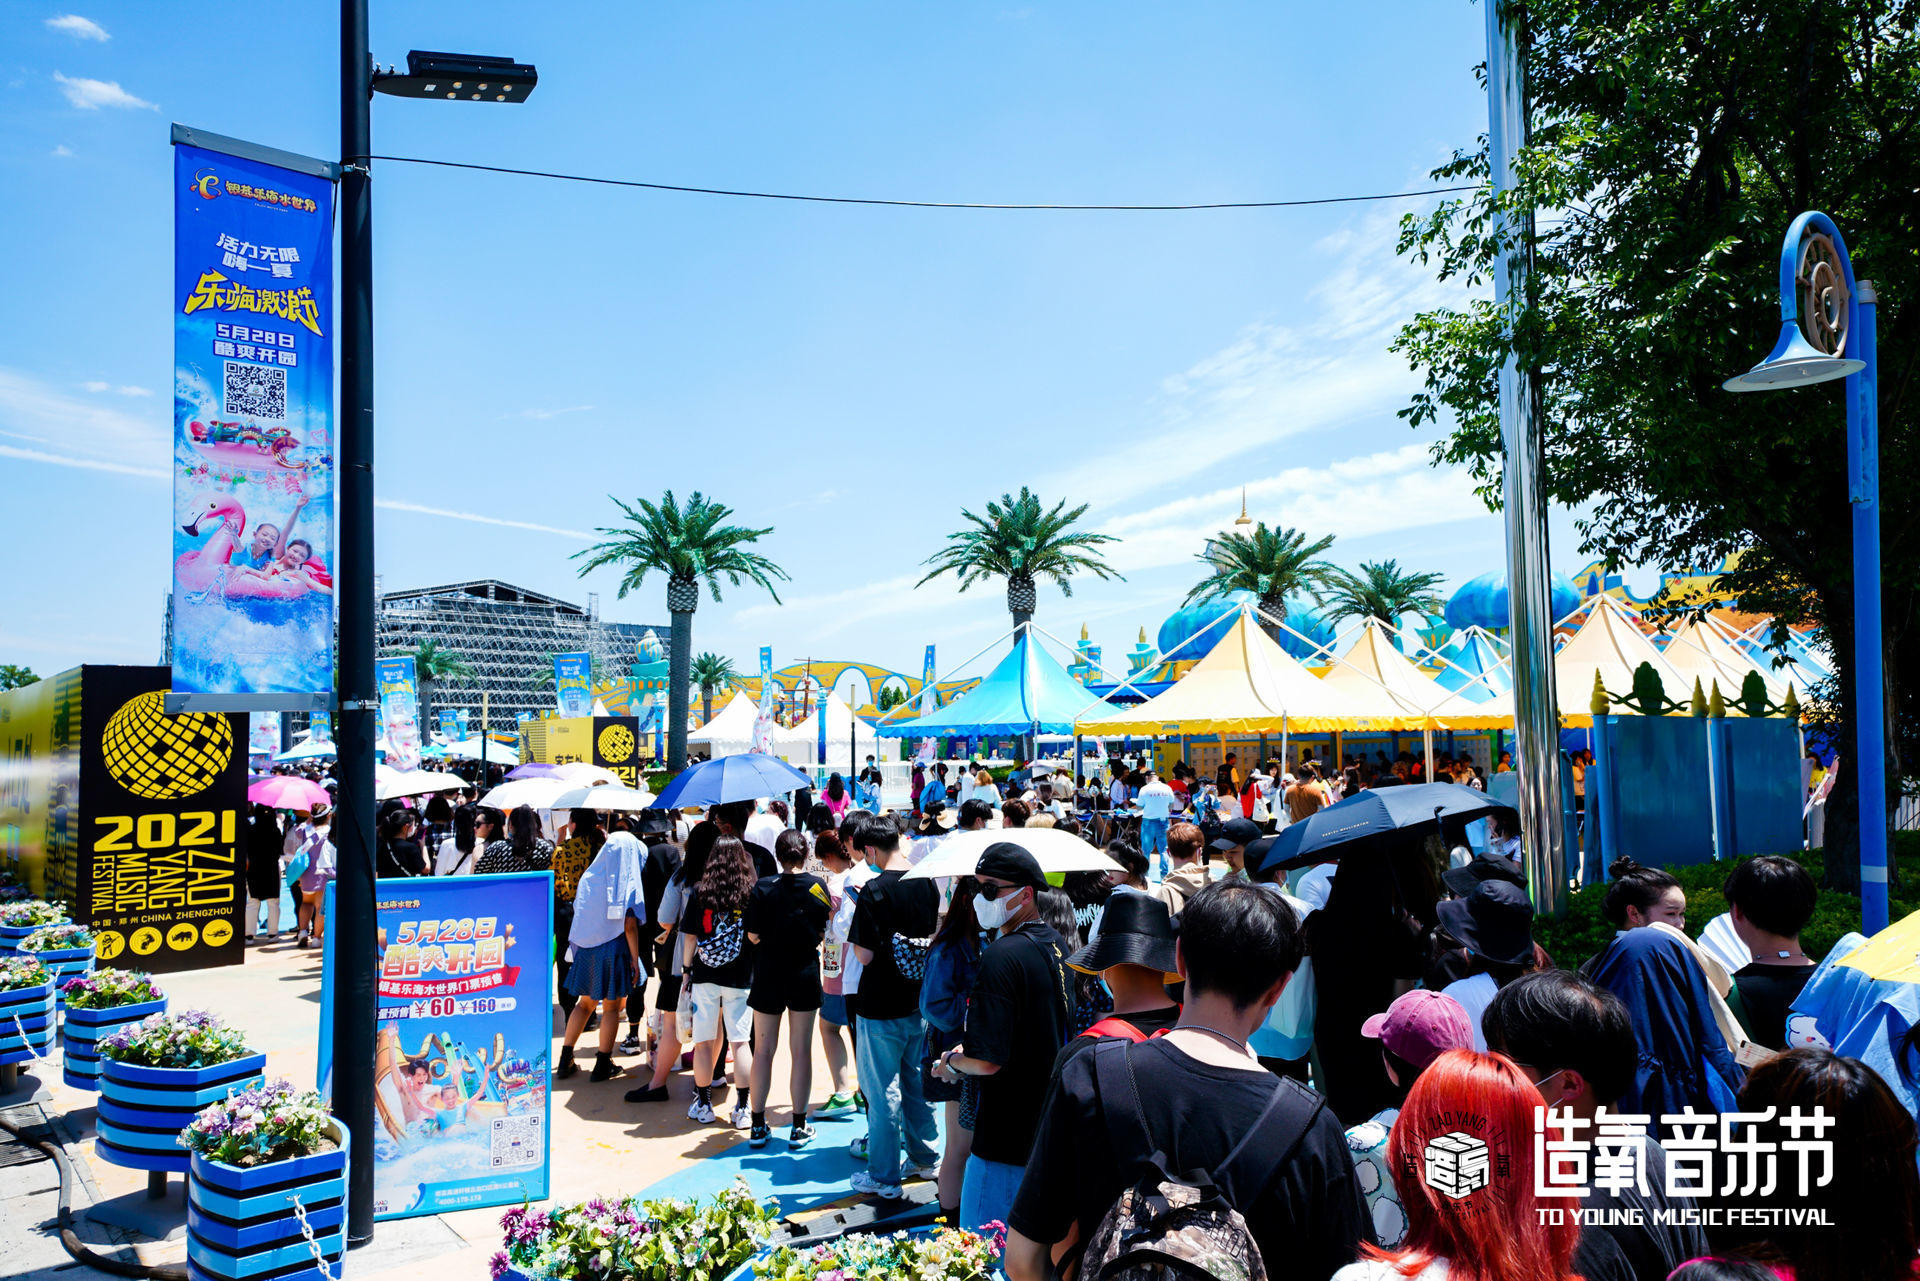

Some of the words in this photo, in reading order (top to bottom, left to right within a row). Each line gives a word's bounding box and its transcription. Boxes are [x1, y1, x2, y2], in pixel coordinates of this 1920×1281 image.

[216, 232, 300, 262] 活力无限
[222, 251, 294, 279] 嗨一夏
[214, 340, 297, 366] 酷爽开园
[217, 323, 295, 348] 5月28日
[94, 810, 235, 852] 2021
[92, 855, 114, 915] FESTIVAL
[115, 853, 148, 912] MUSIC
[149, 851, 186, 909] YANG
[187, 848, 235, 905] ZAO
[141, 913, 172, 923] CHINA
[176, 907, 233, 920] ZHENGZHOU
[397, 917, 497, 944] 5月28日
[382, 936, 505, 979] 酷爽开园
